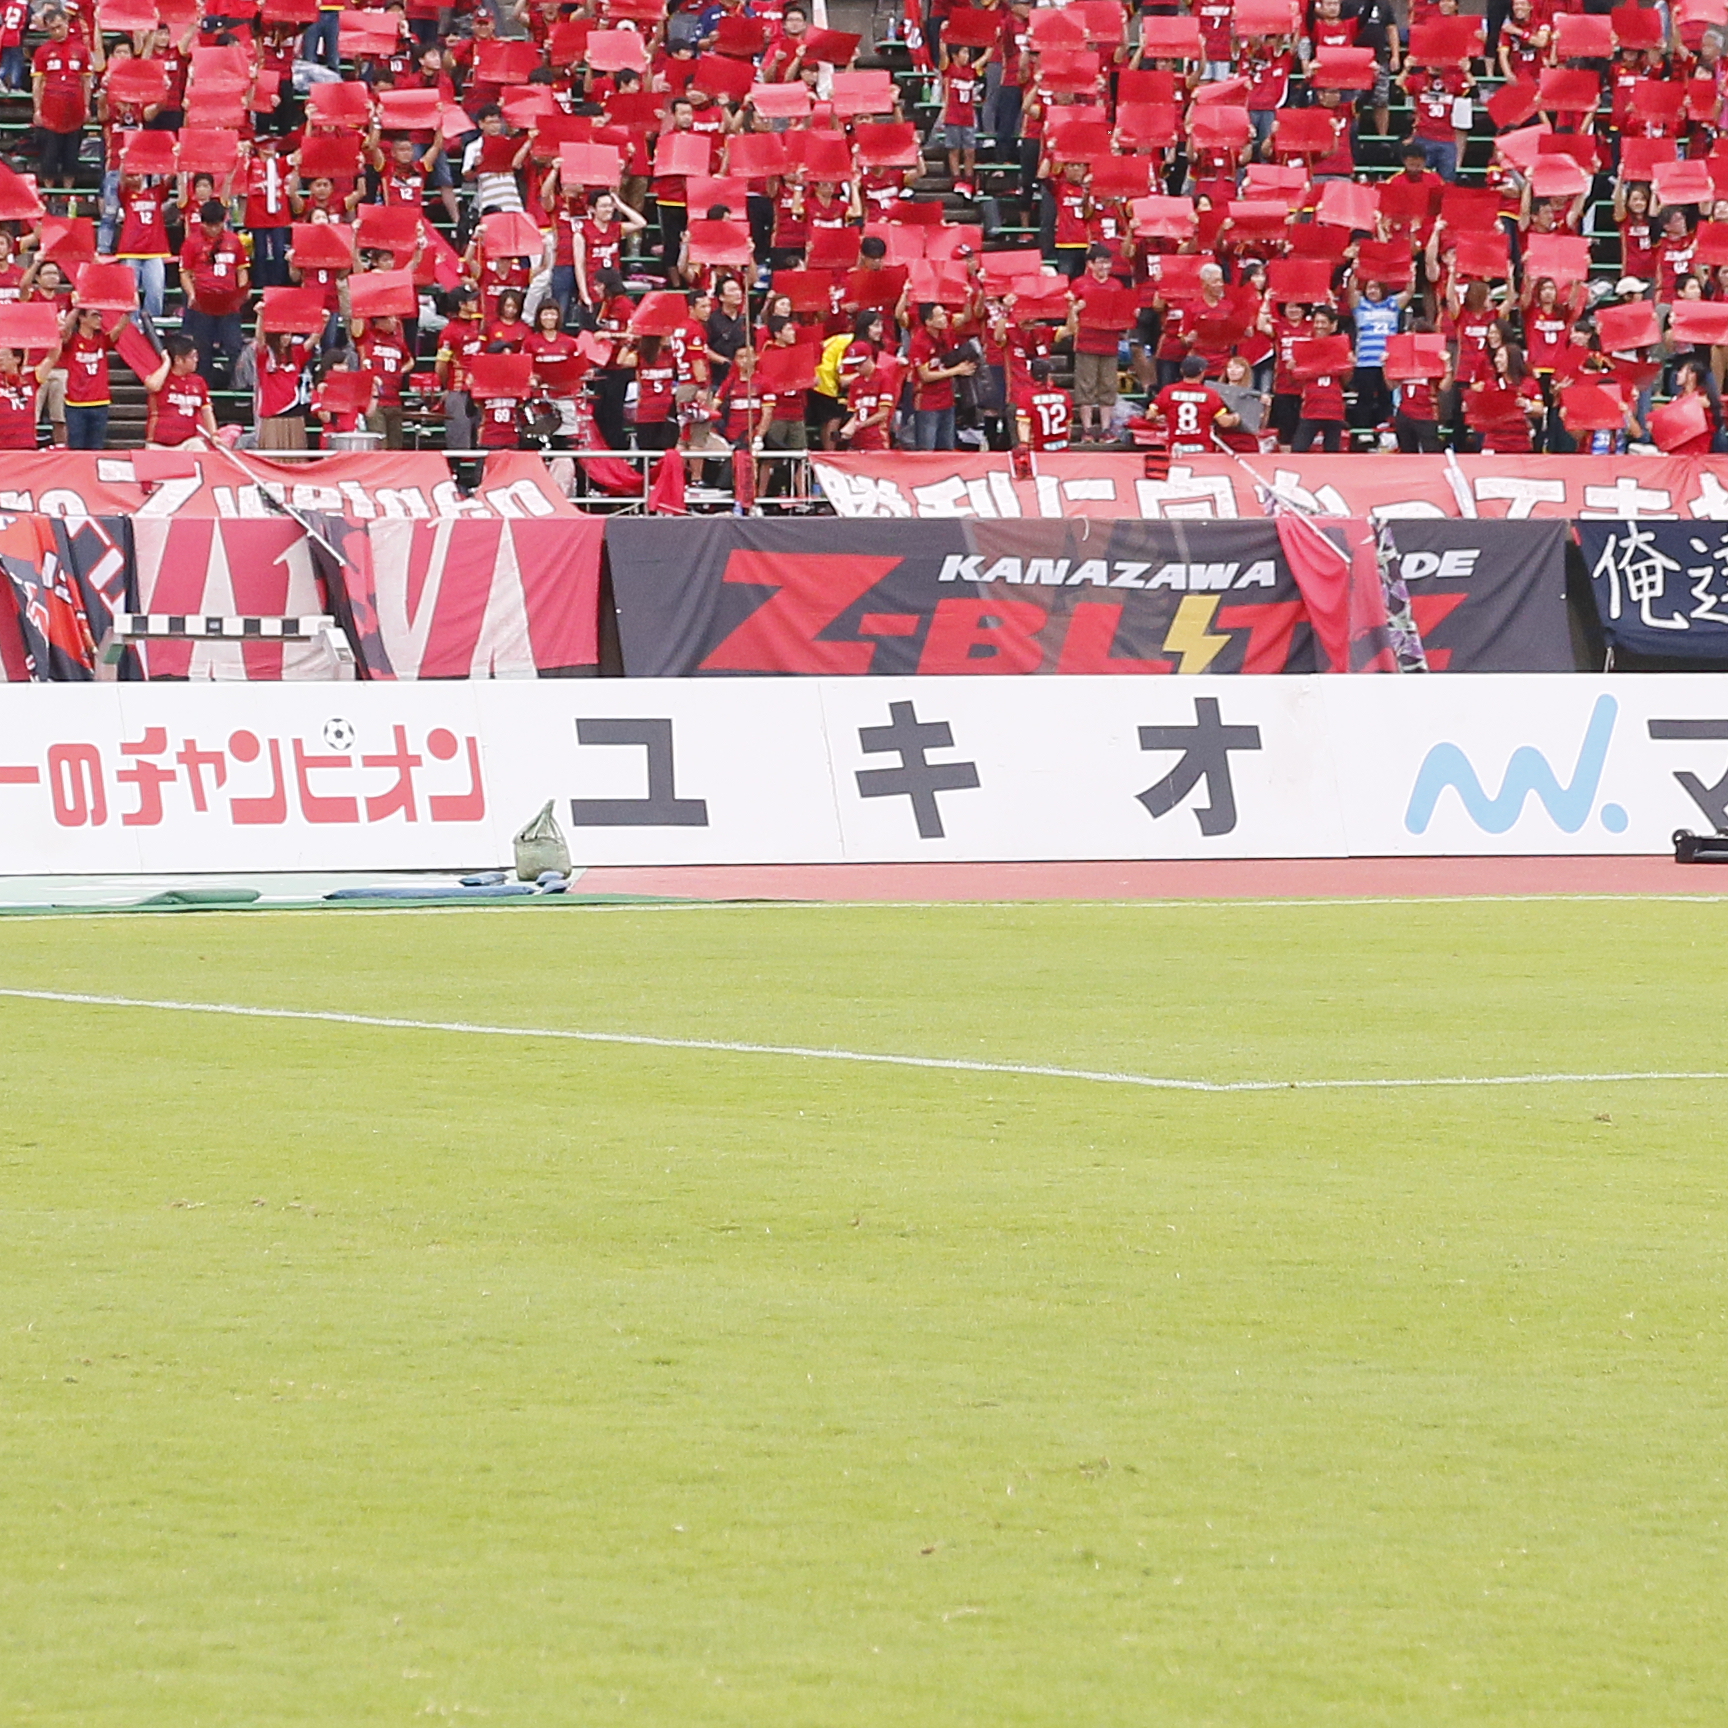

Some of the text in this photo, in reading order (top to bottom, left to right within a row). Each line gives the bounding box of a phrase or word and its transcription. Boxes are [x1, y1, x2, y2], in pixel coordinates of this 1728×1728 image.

[1038, 404, 1068, 436] 12
[1177, 401, 1197, 432] 8
[938, 554, 1276, 591] KANAZAWA
[571, 697, 1263, 839] ユキオ
